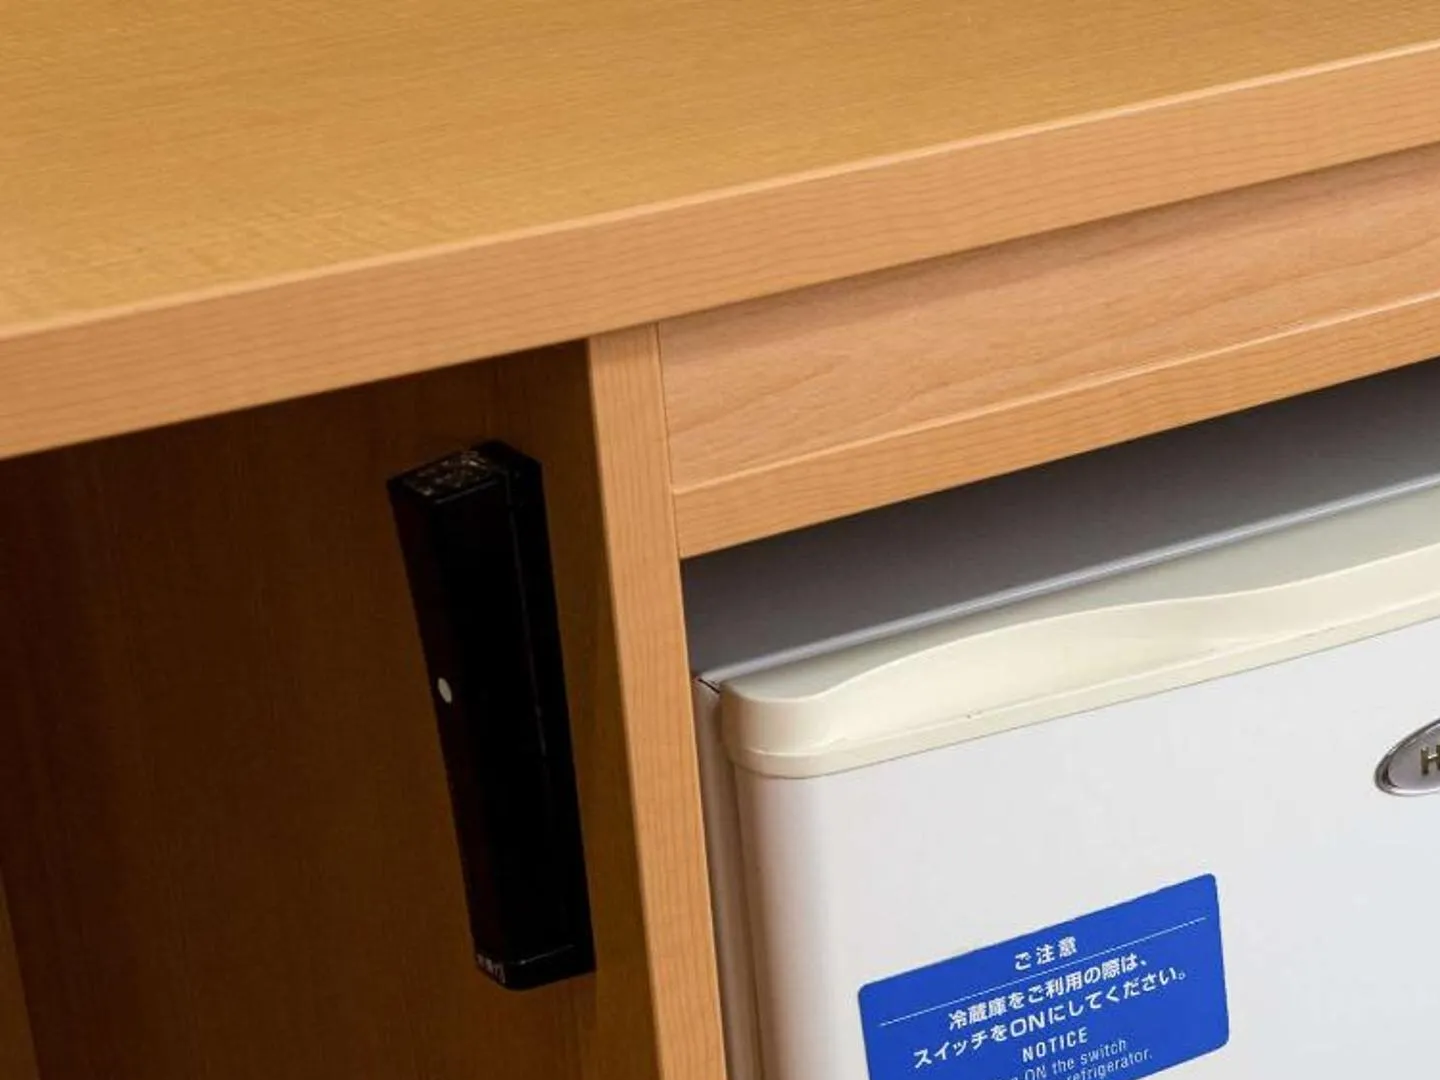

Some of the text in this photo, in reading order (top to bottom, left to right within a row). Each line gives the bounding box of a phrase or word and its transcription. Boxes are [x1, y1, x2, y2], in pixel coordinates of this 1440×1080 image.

[1014, 936, 1077, 971] ご注意
[948, 952, 1148, 1031] 冷蔵庫をご利用の際は、
[914, 966, 1186, 1069] スイッチをONにしてください。
[1022, 1027, 1089, 1062] NOTICE
[1052, 1056, 1074, 1074] the
[1080, 1038, 1127, 1065] switch
